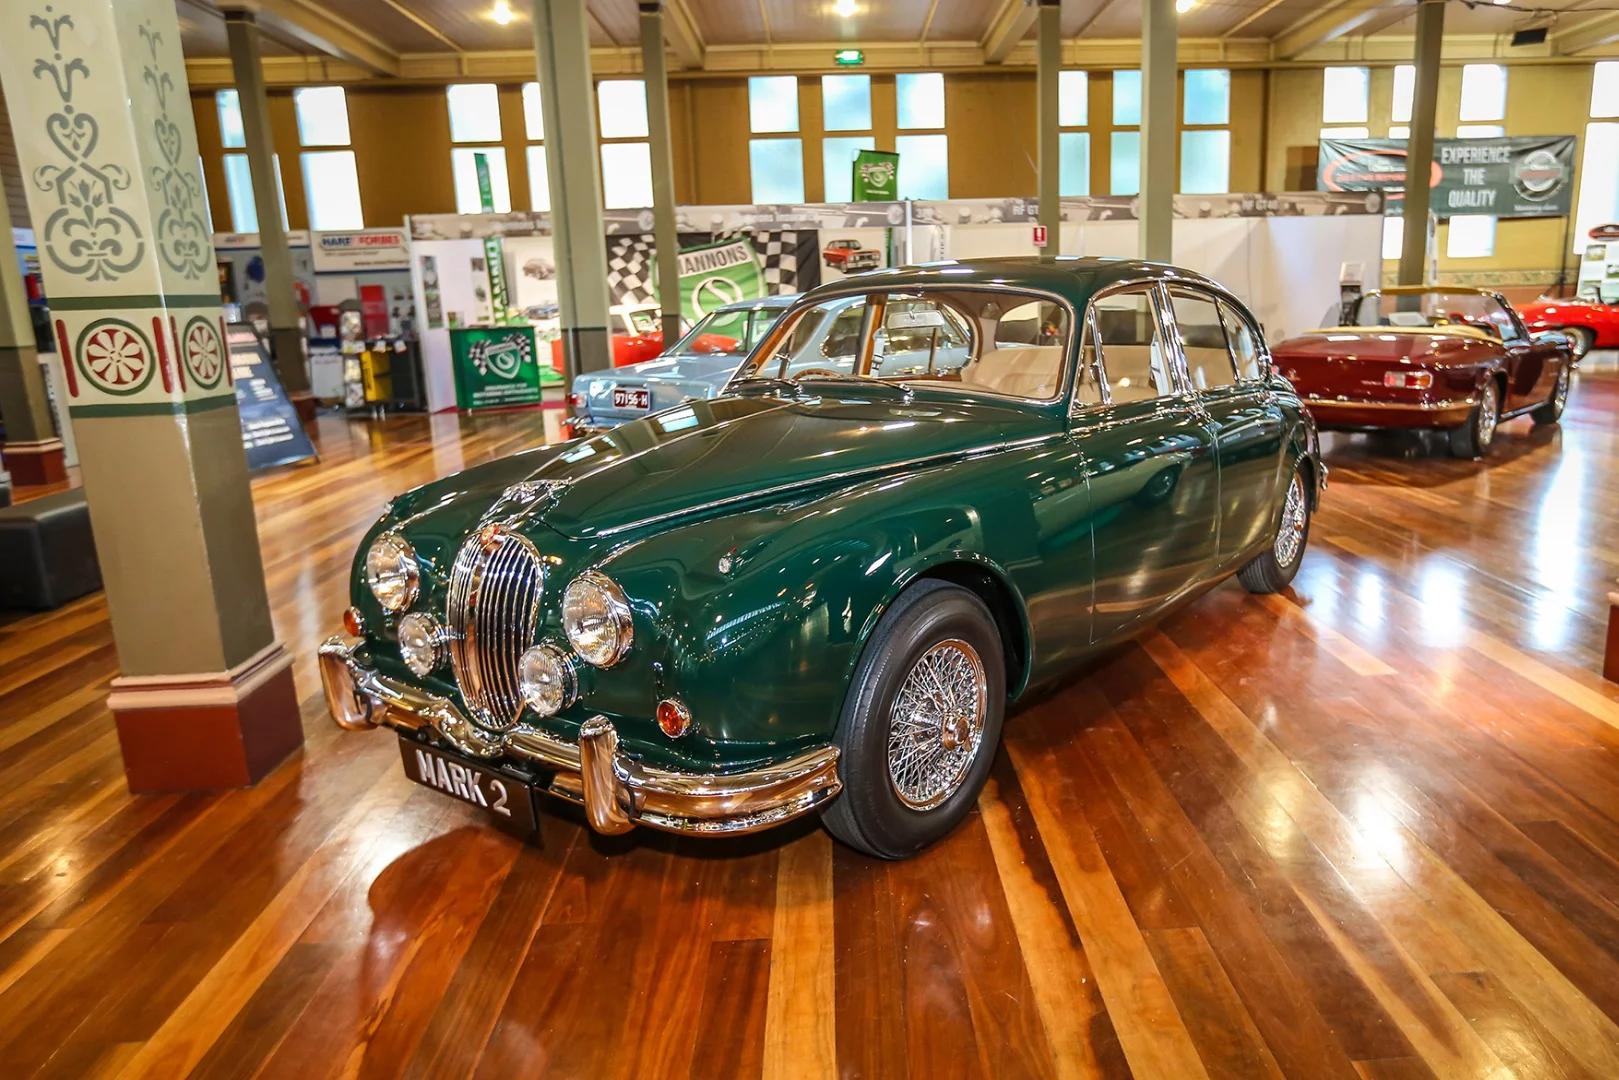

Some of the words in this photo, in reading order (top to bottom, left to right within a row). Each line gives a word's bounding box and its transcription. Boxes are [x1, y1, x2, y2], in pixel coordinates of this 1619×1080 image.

[1441, 147, 1511, 165] EXPERIENCE
[1463, 167, 1486, 185] THE
[1448, 189, 1497, 208] QUALITY
[680, 245, 748, 276] ANNONS
[615, 392, 648, 406] 97156-H
[415, 749, 488, 807] MARK
[490, 779, 512, 817] 2
